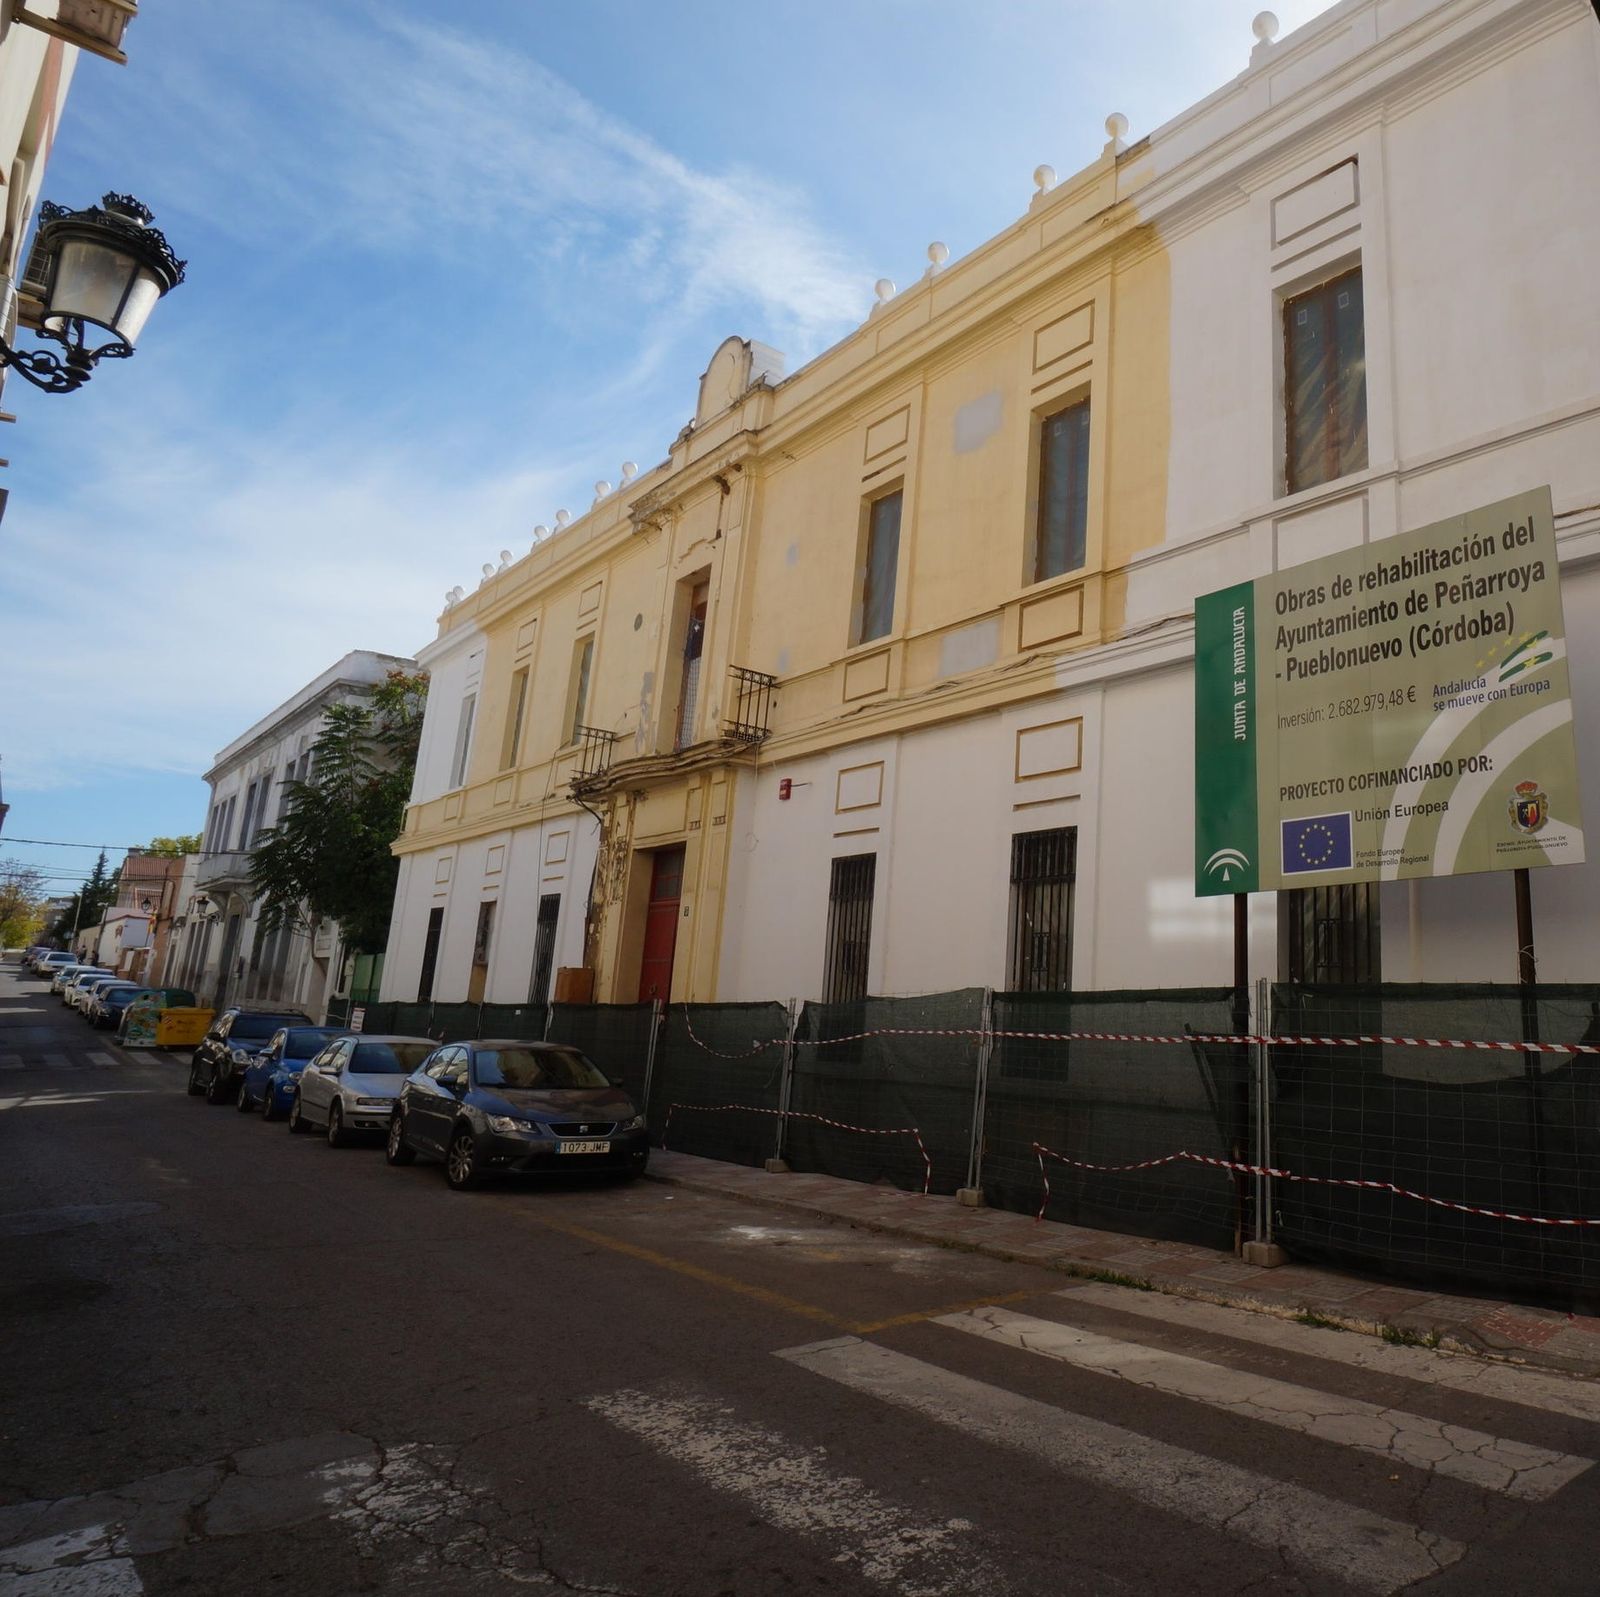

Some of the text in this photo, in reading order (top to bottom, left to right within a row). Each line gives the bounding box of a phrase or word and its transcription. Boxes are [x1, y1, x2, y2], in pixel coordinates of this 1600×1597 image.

[1275, 515, 1535, 615] Obras de rehabilitación del
[1275, 560, 1545, 653] Ayuntamiento de Peñarroya
[1286, 637, 1402, 681] Pueblonuevo
[1409, 600, 1515, 659] (Córdoba)
[1234, 678, 1246, 696] DE
[1433, 676, 1487, 698] Andalucía
[1433, 679, 1551, 712] se mueve con Europa
[1234, 700, 1246, 740] JUNTA
[1277, 685, 1416, 729] Inversión: 2.682.979,48 €
[1280, 754, 1493, 802] PROYECTO COFINANCIADO POR:
[1354, 800, 1449, 822] Unión Europea
[1400, 854, 1430, 865] Regional
[563, 1142, 608, 1153] 1073 JMF
